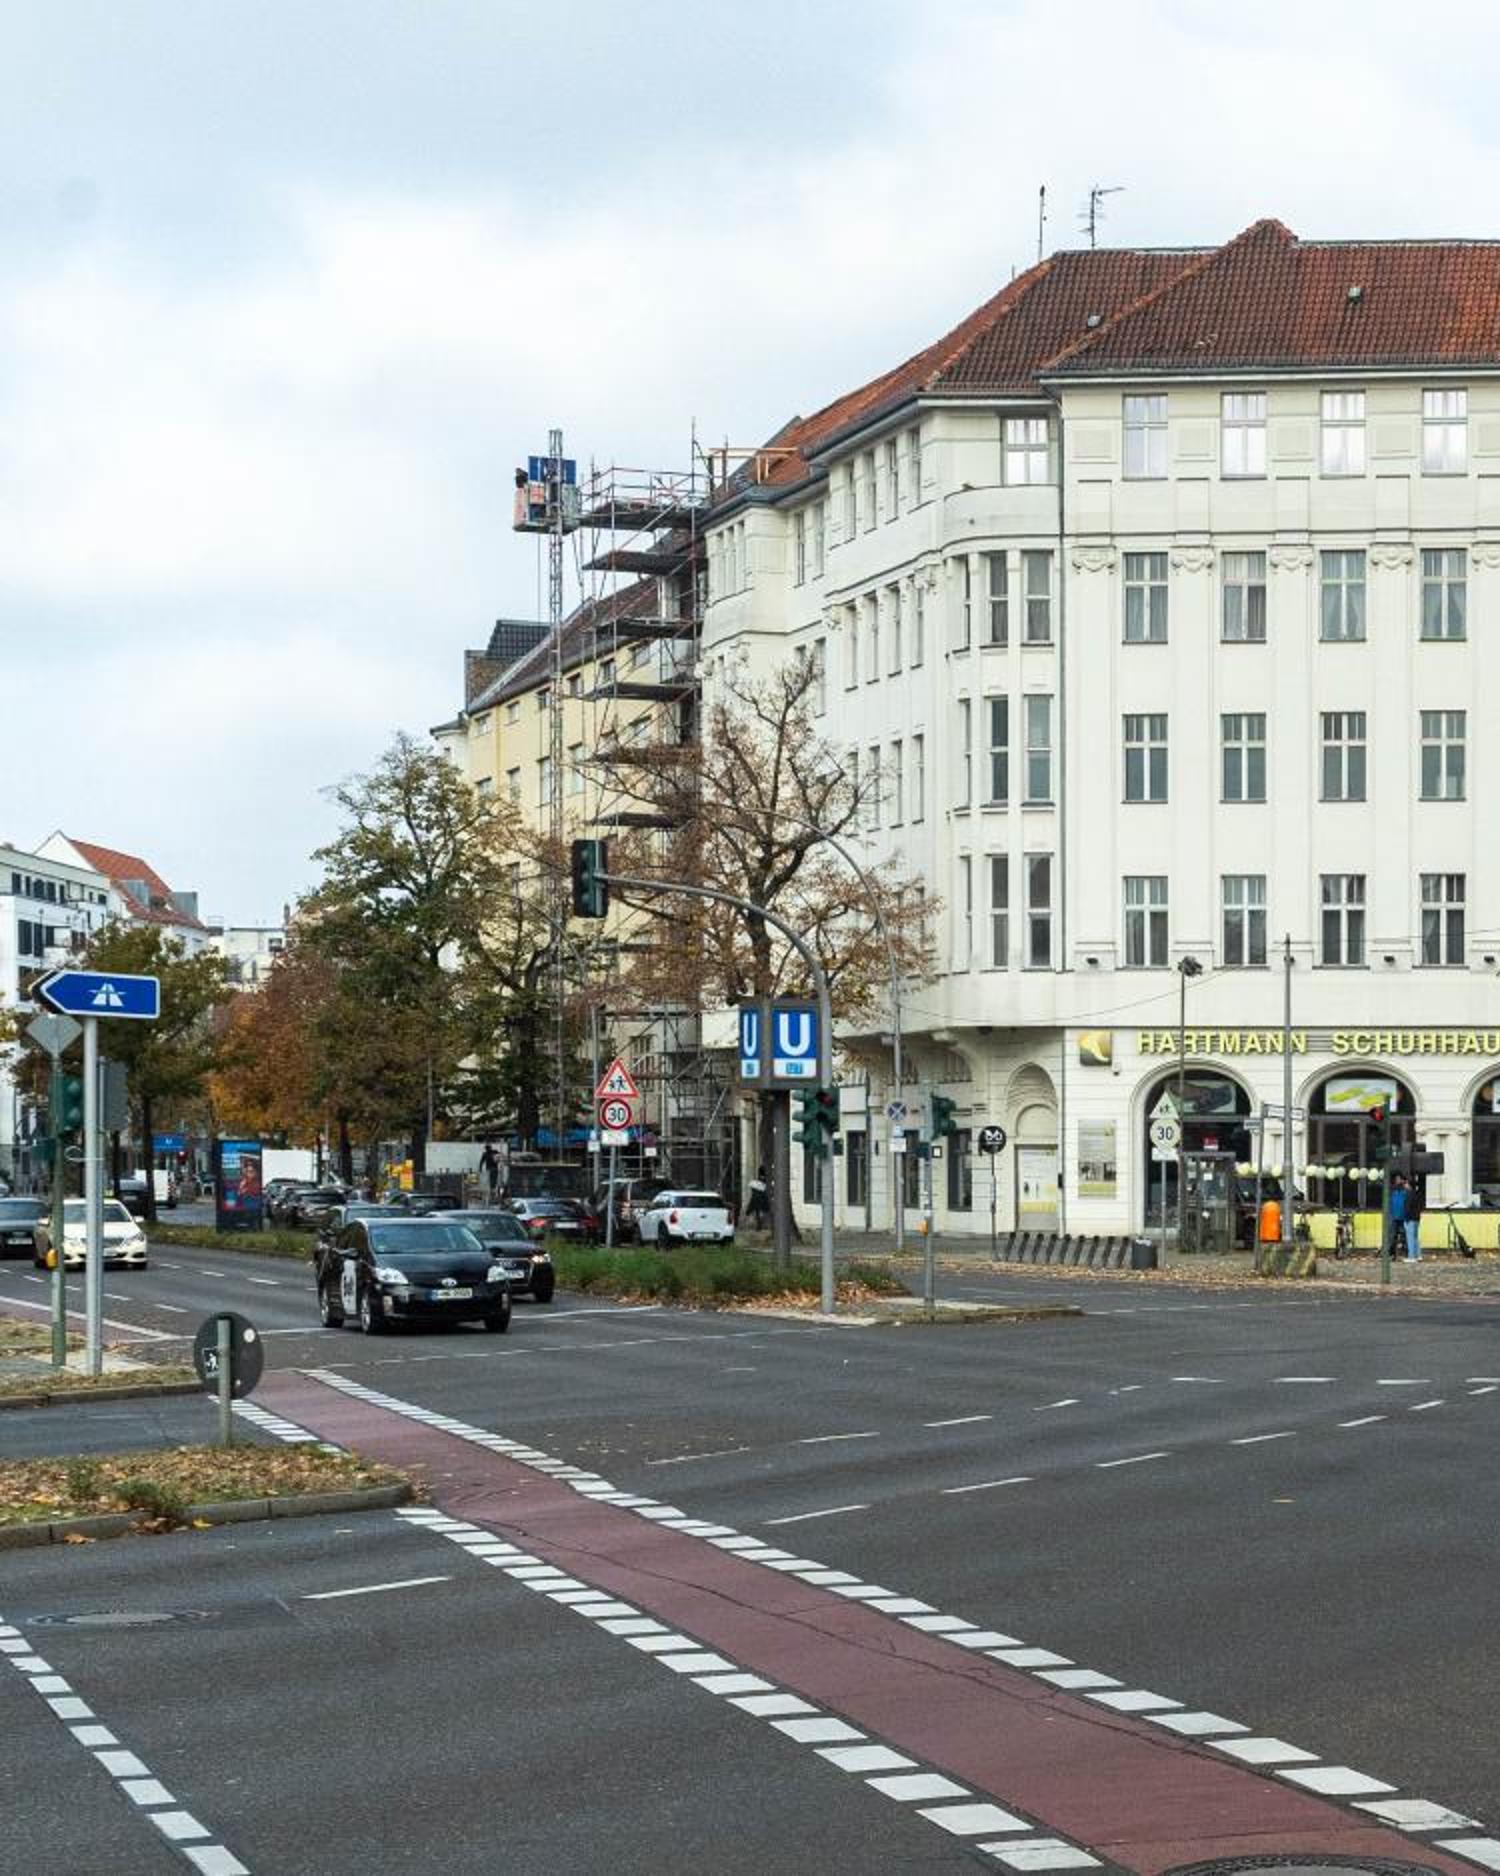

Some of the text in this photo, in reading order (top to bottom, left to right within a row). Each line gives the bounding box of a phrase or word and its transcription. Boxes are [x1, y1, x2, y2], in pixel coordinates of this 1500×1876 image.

[743, 1013, 757, 1056] U
[779, 1013, 811, 1056] U
[1136, 1030, 1308, 1055] HARTMANN
[607, 1107, 626, 1121] 30
[1156, 1126, 1175, 1140] 30
